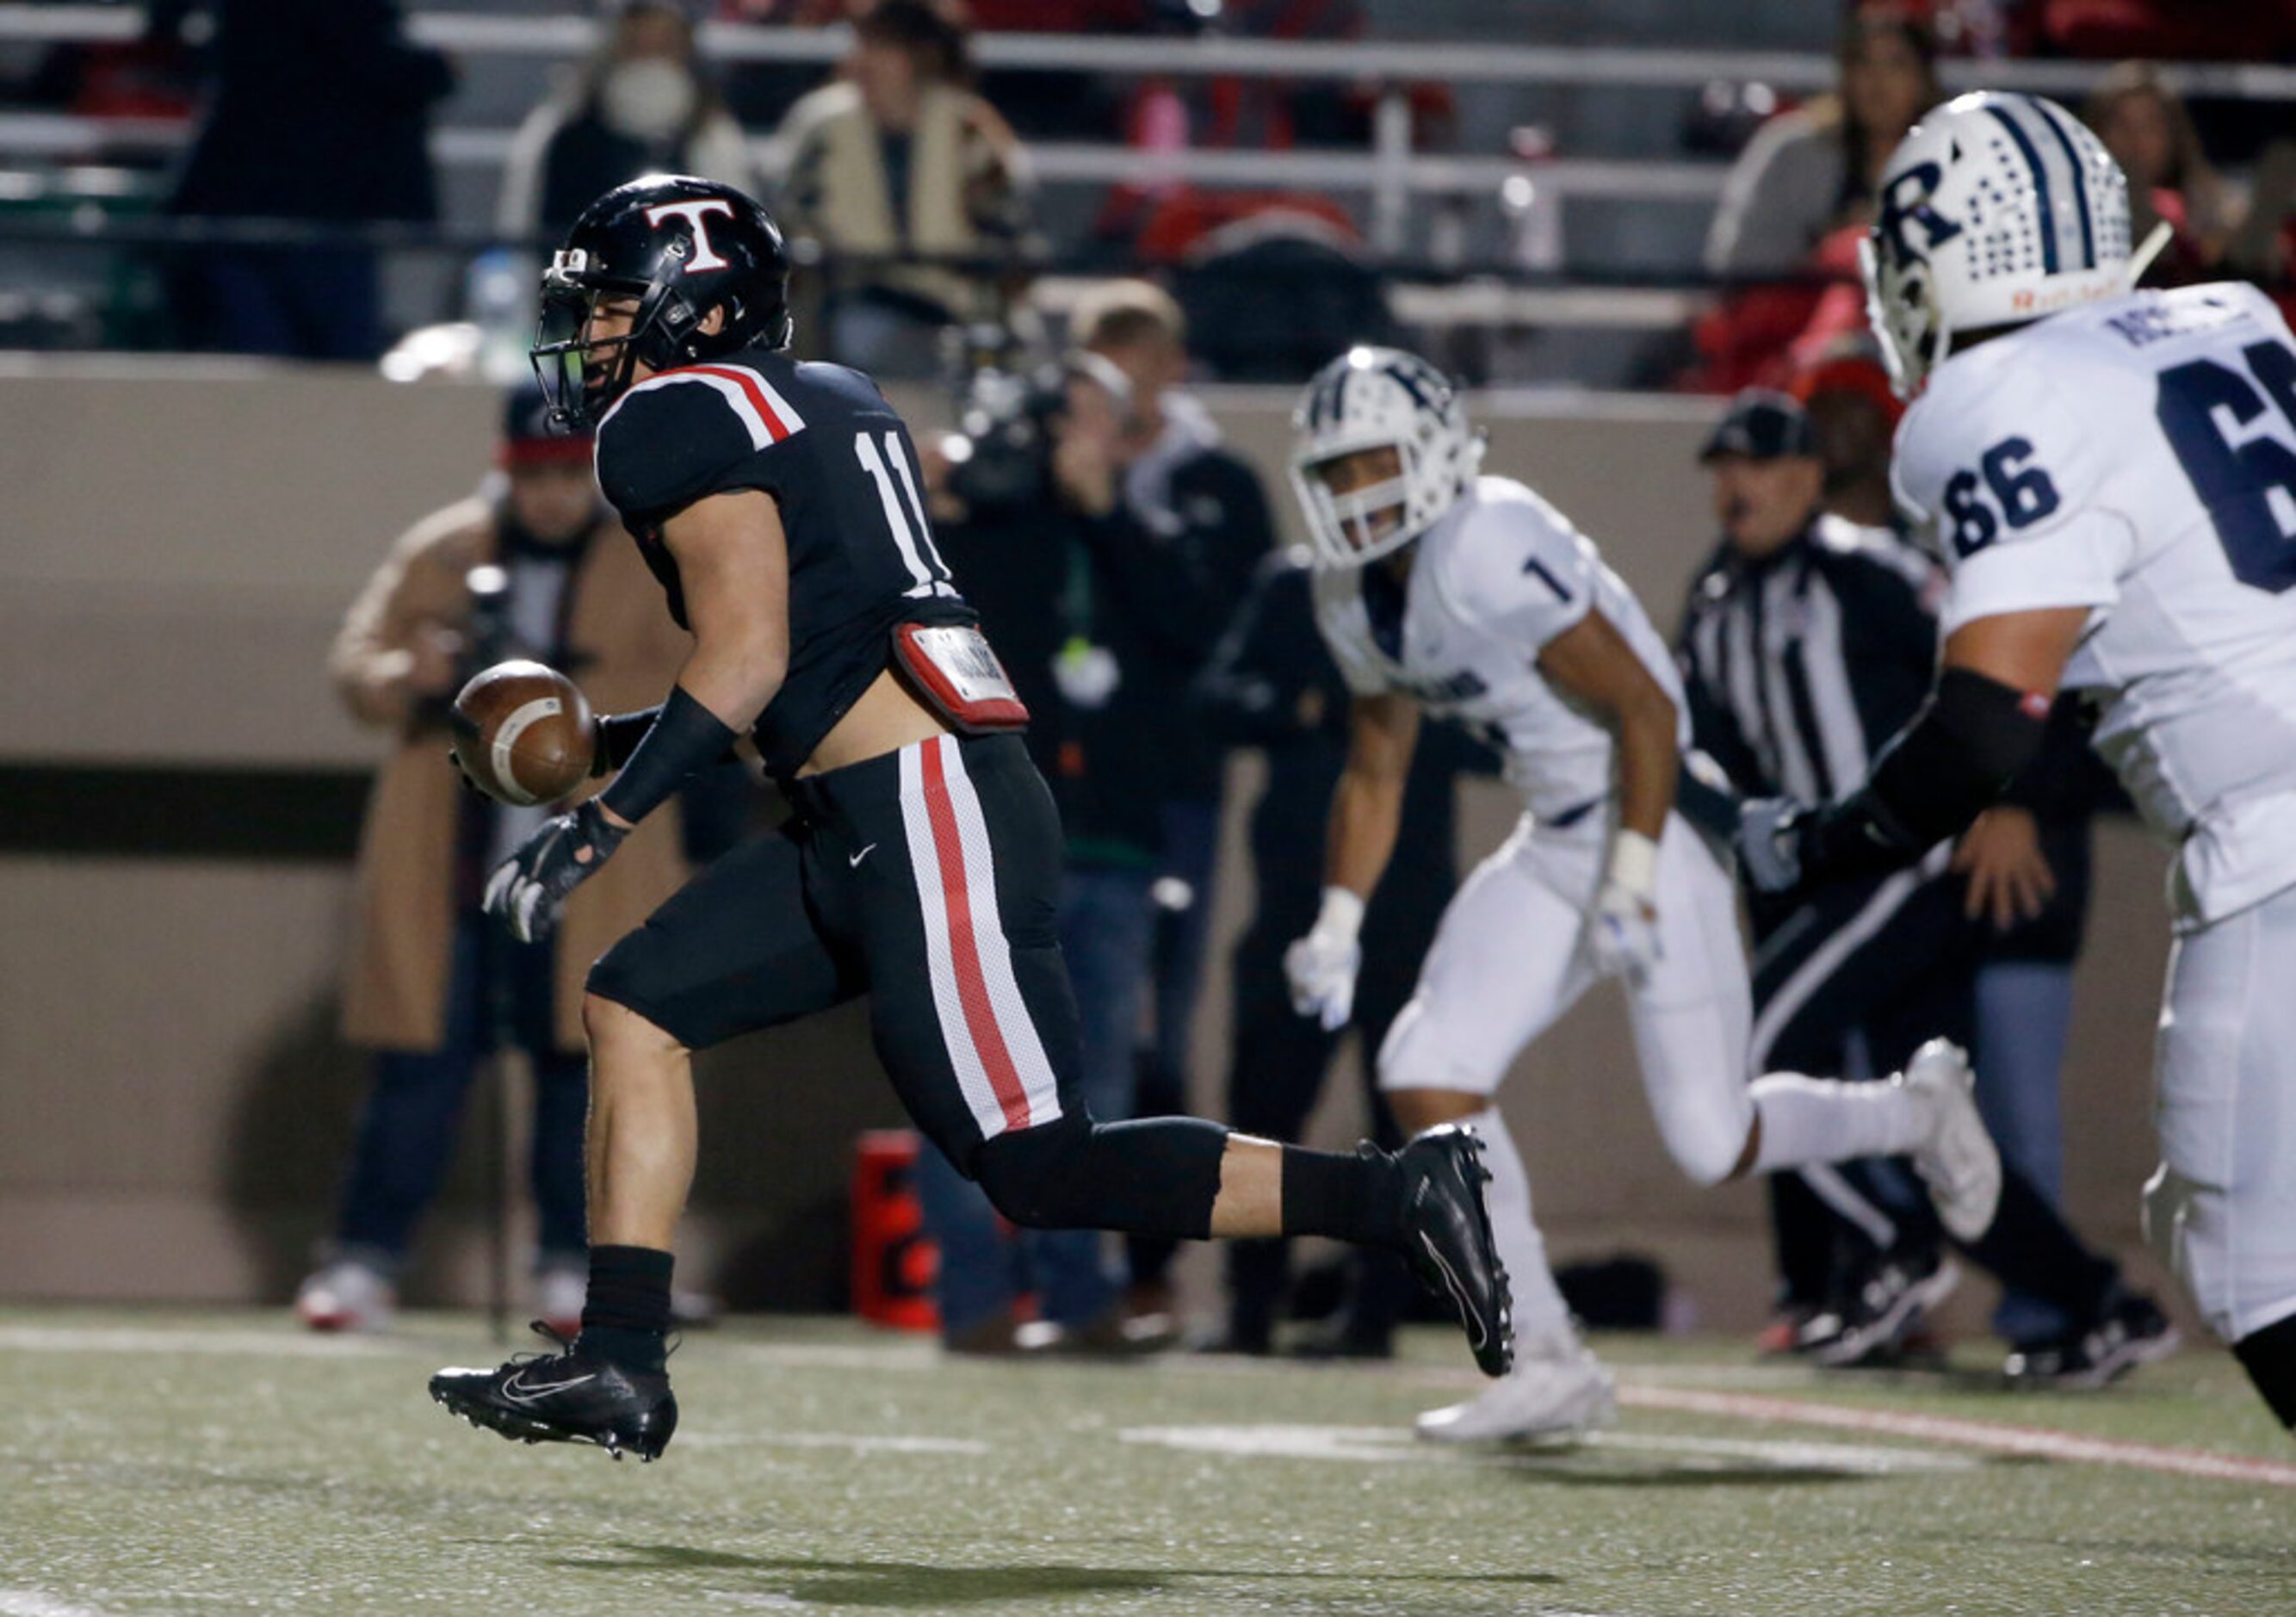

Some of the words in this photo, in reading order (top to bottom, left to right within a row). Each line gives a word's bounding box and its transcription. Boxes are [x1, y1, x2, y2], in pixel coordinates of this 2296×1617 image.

[647, 199, 735, 275] T
[1882, 160, 1965, 274] R
[854, 431, 962, 599] 11
[1944, 437, 2060, 560] 66
[1522, 555, 1574, 604] 1
